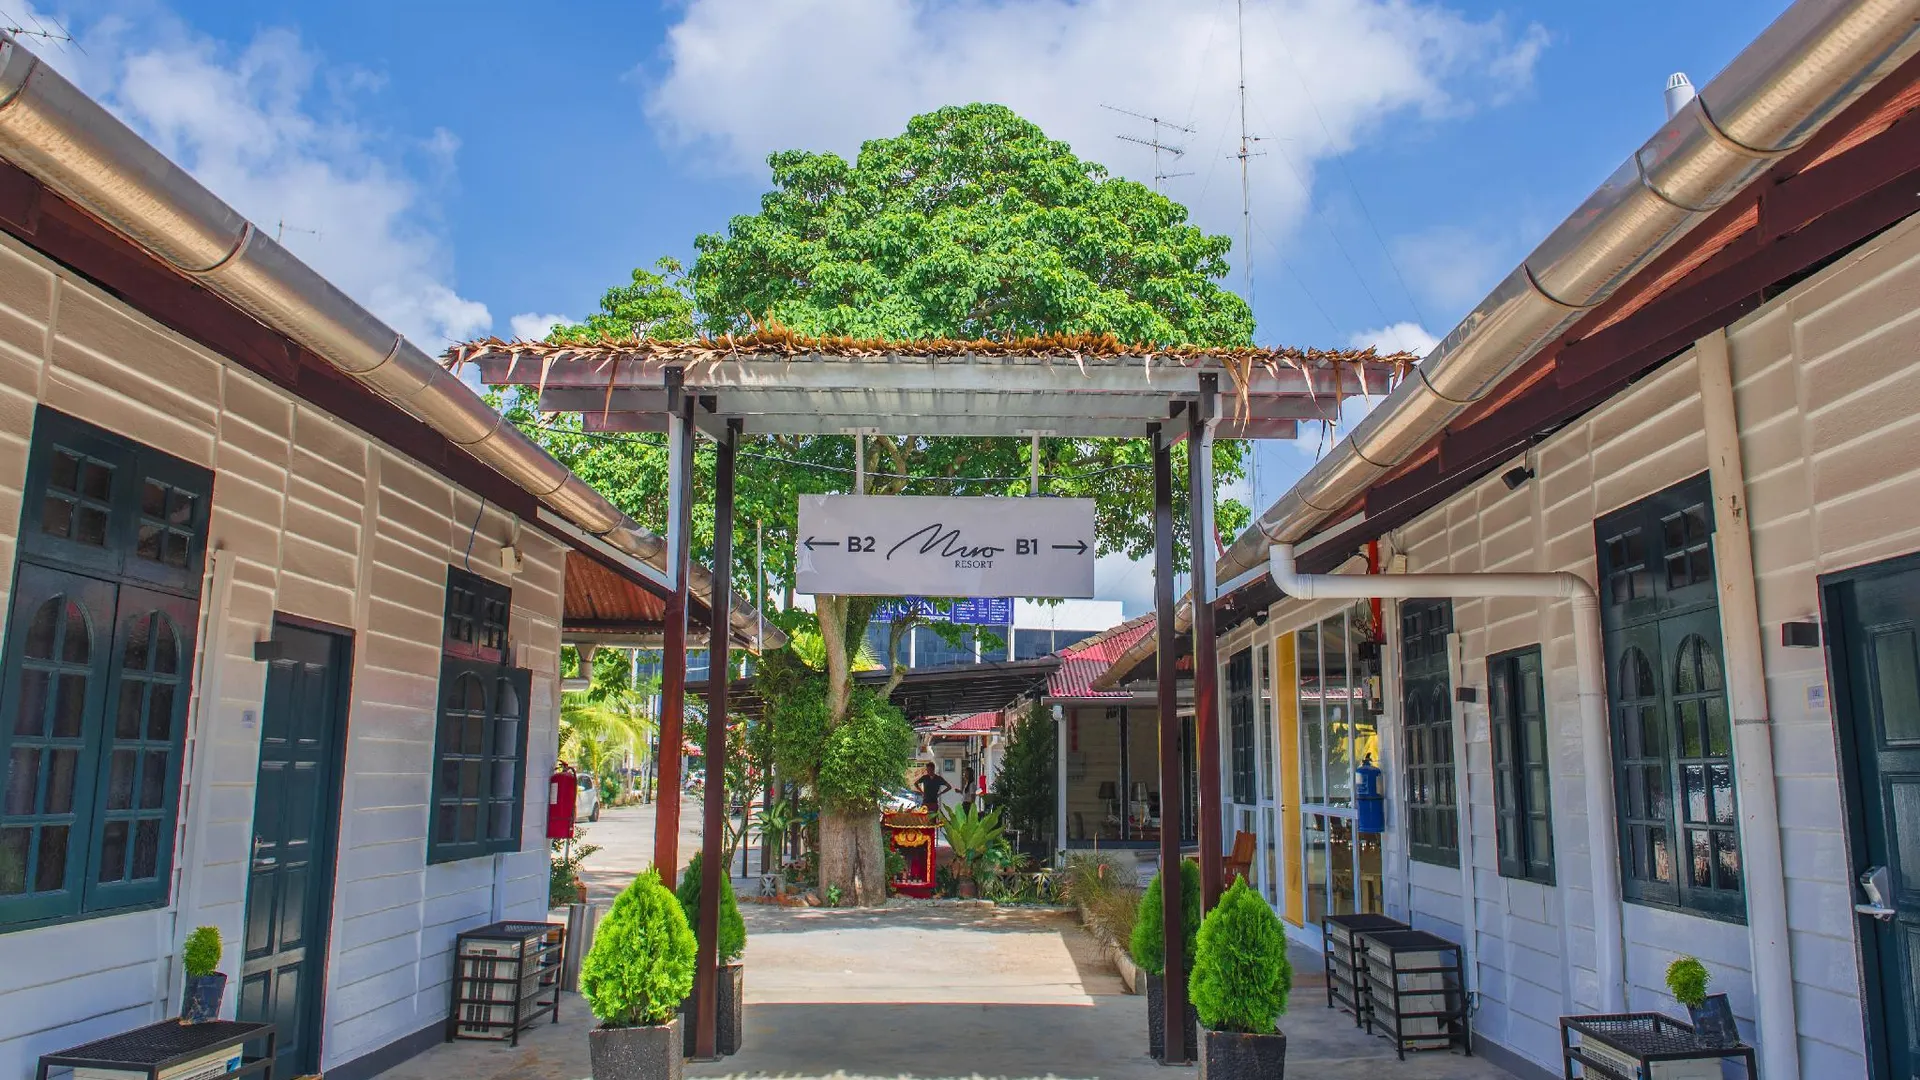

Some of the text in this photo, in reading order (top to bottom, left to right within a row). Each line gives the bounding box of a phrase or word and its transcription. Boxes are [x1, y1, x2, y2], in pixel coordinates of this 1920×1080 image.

[847, 536, 876, 552] B2
[1015, 539, 1038, 555] B1
[954, 559, 994, 569] RESORT
